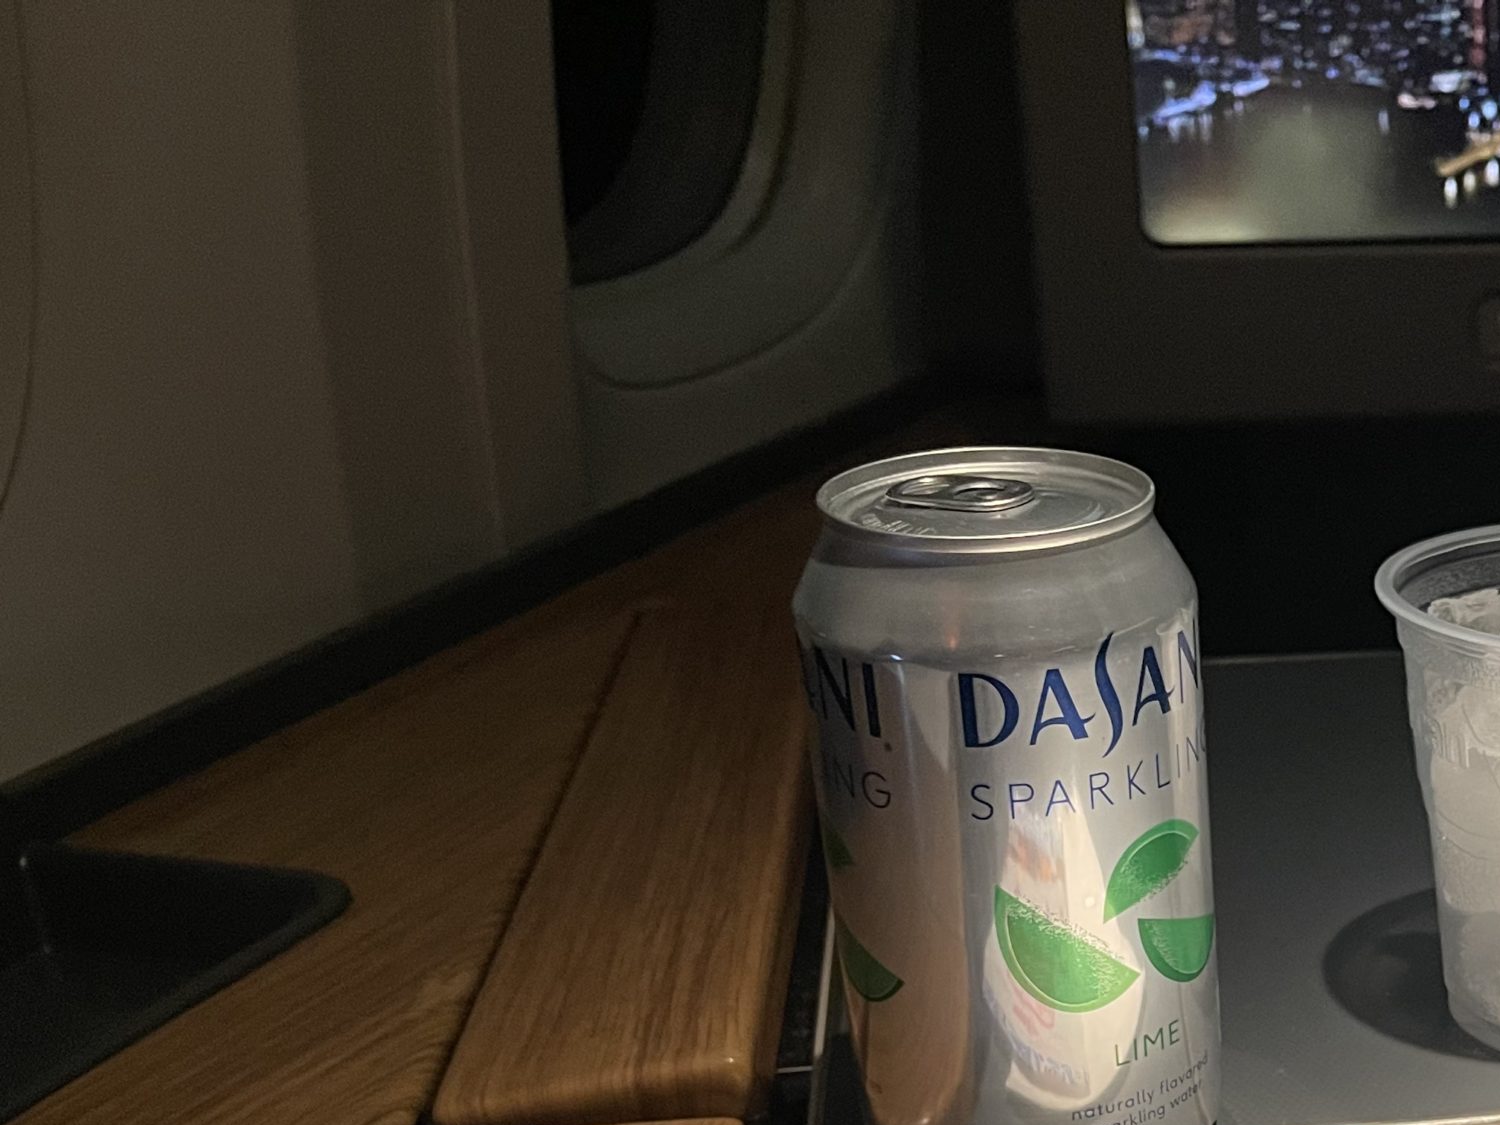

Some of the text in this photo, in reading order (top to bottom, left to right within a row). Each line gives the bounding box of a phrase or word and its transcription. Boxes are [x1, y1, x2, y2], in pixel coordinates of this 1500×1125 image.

[957, 616, 1200, 758] DASAN
[970, 727, 1206, 821] SPARKLIN
[1115, 1019, 1180, 1067] LIME
[1071, 1089, 1155, 1122] naturally
